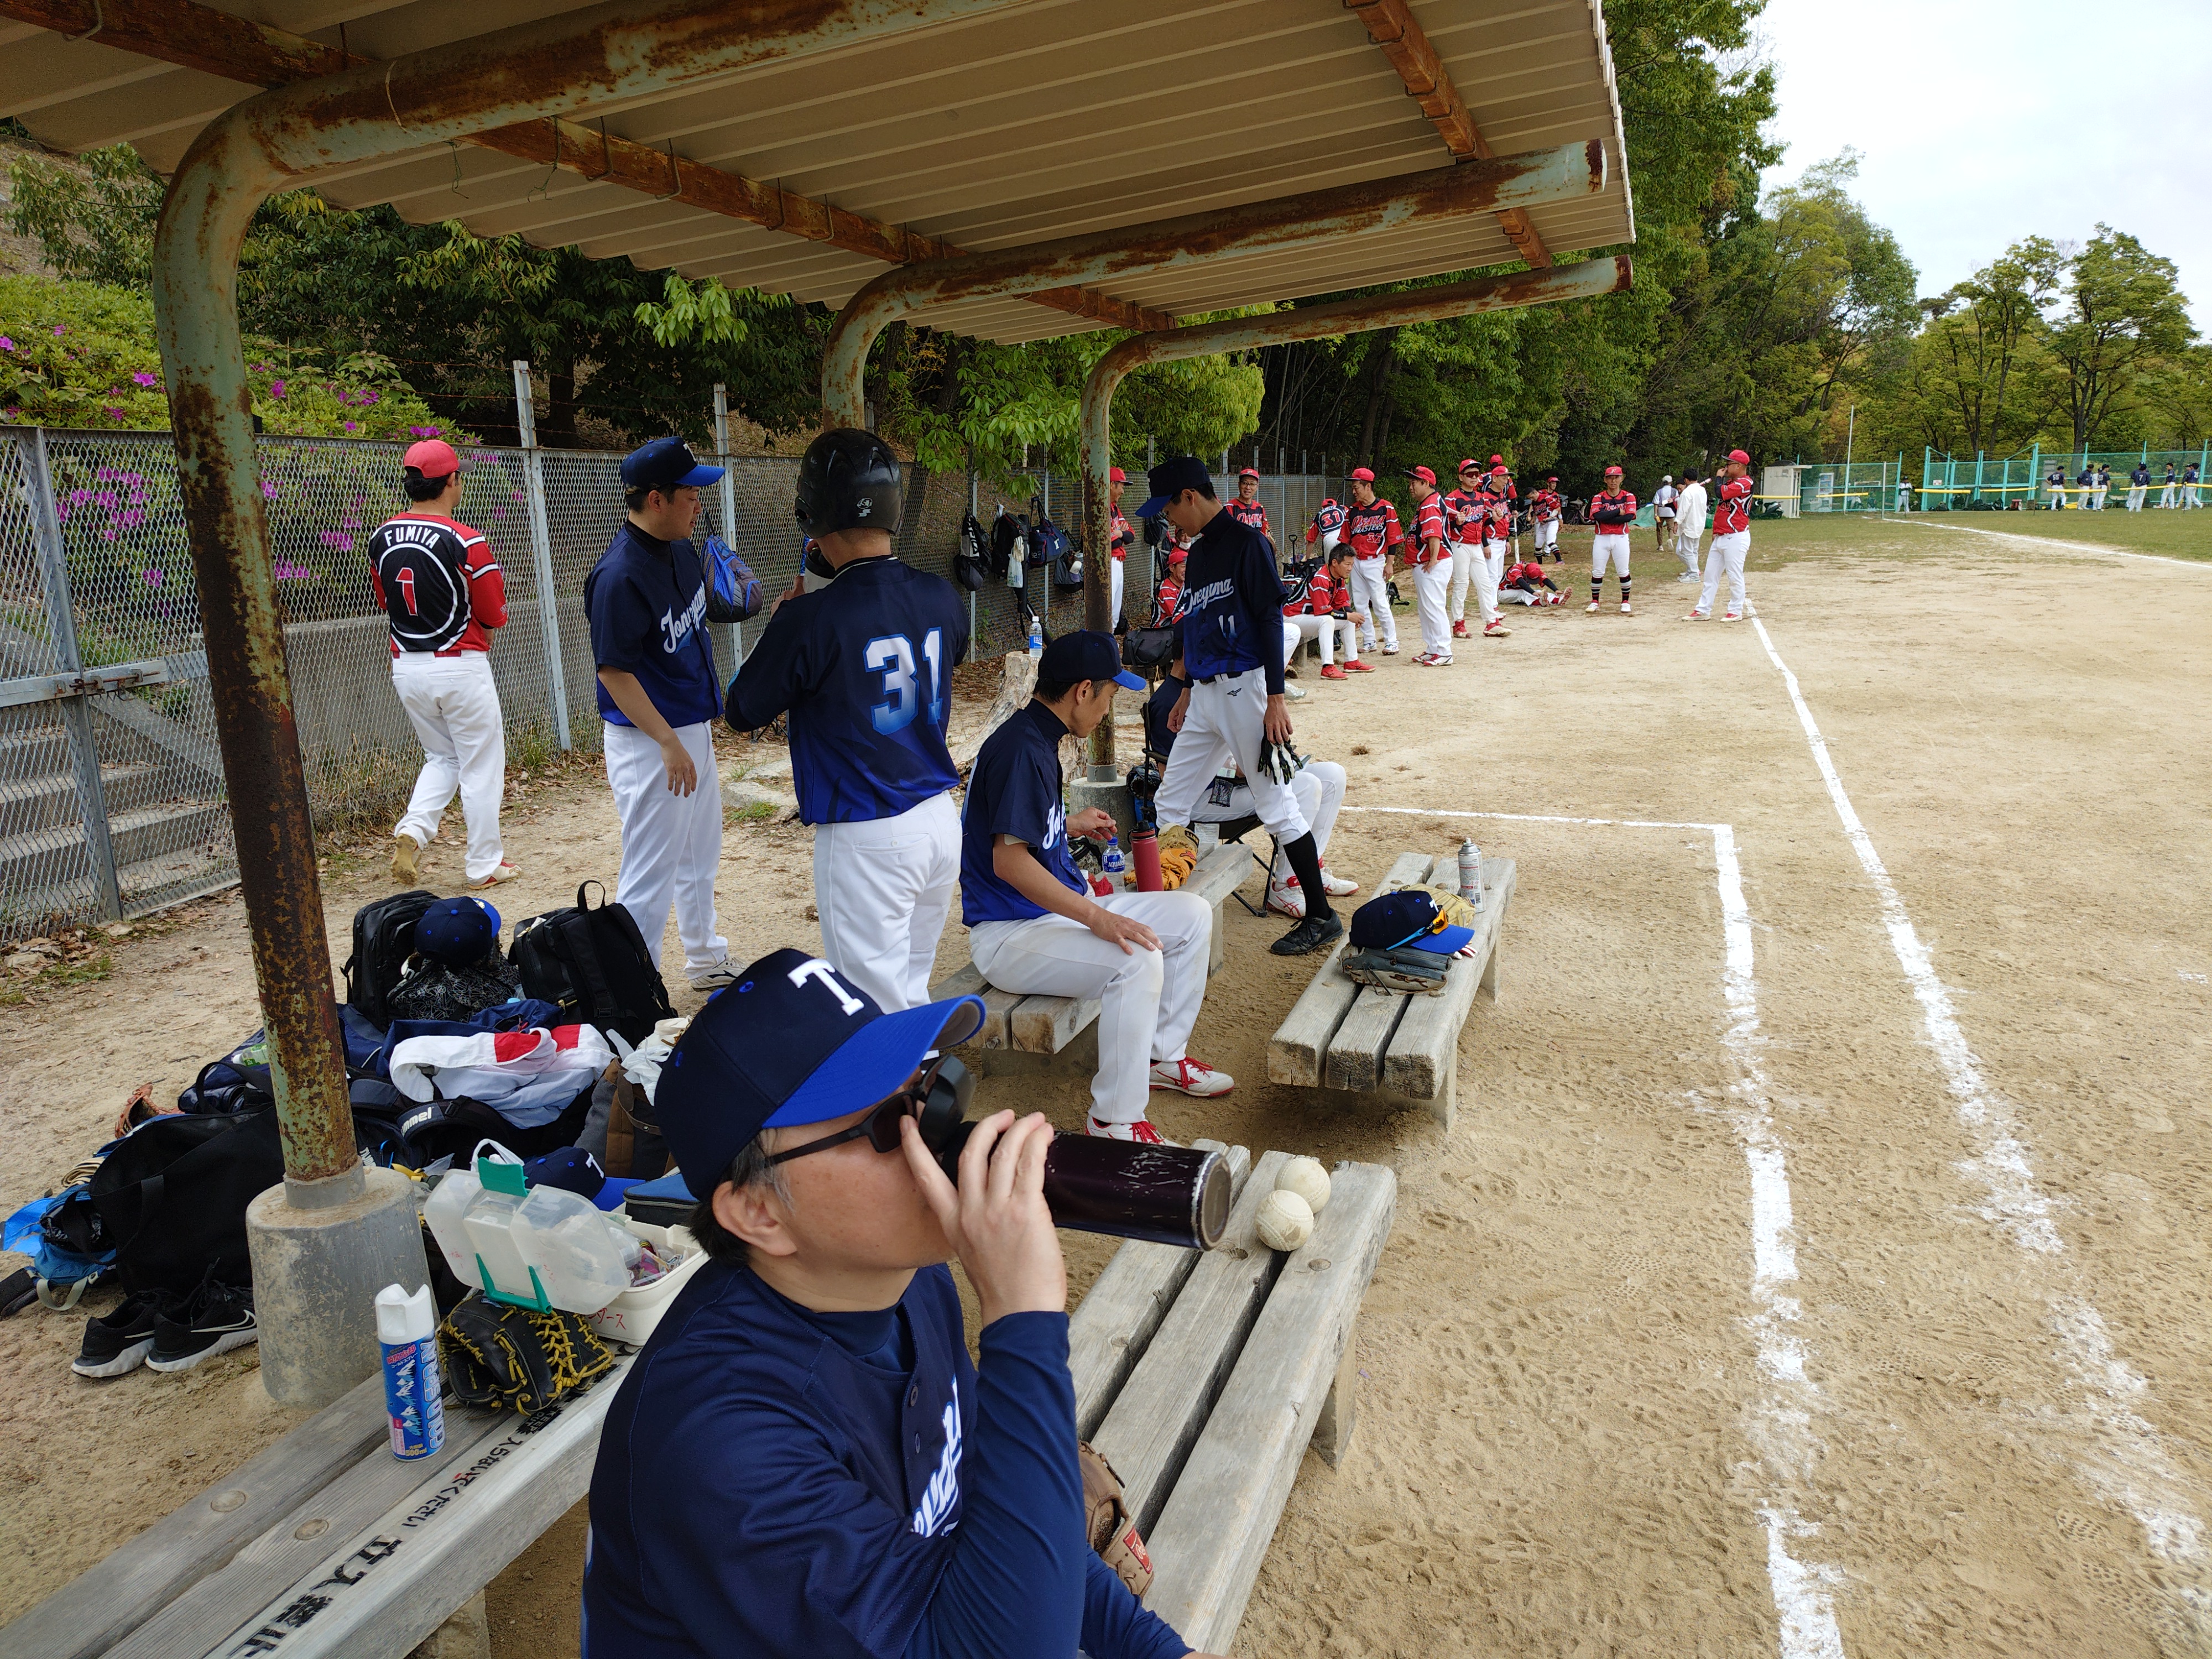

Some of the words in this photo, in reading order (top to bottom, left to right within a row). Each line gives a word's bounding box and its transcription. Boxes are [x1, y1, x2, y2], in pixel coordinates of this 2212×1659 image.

[384, 526, 440, 549] FUMIYA
[1321, 510, 1340, 527] 31
[395, 567, 419, 617] 1
[1218, 615, 1238, 638] 11
[863, 627, 943, 735] 31
[787, 958, 864, 1016] T
[586, 1152, 604, 1179] T
[420, 1339, 441, 1402] SPRAY
[426, 1396, 445, 1449] COLD
[525, 1413, 544, 1427] OUT
[530, 1411, 556, 1431] KEEP
[401, 1437, 524, 1527] 入らないでください
[226, 1535, 403, 1657] 立入禁止
